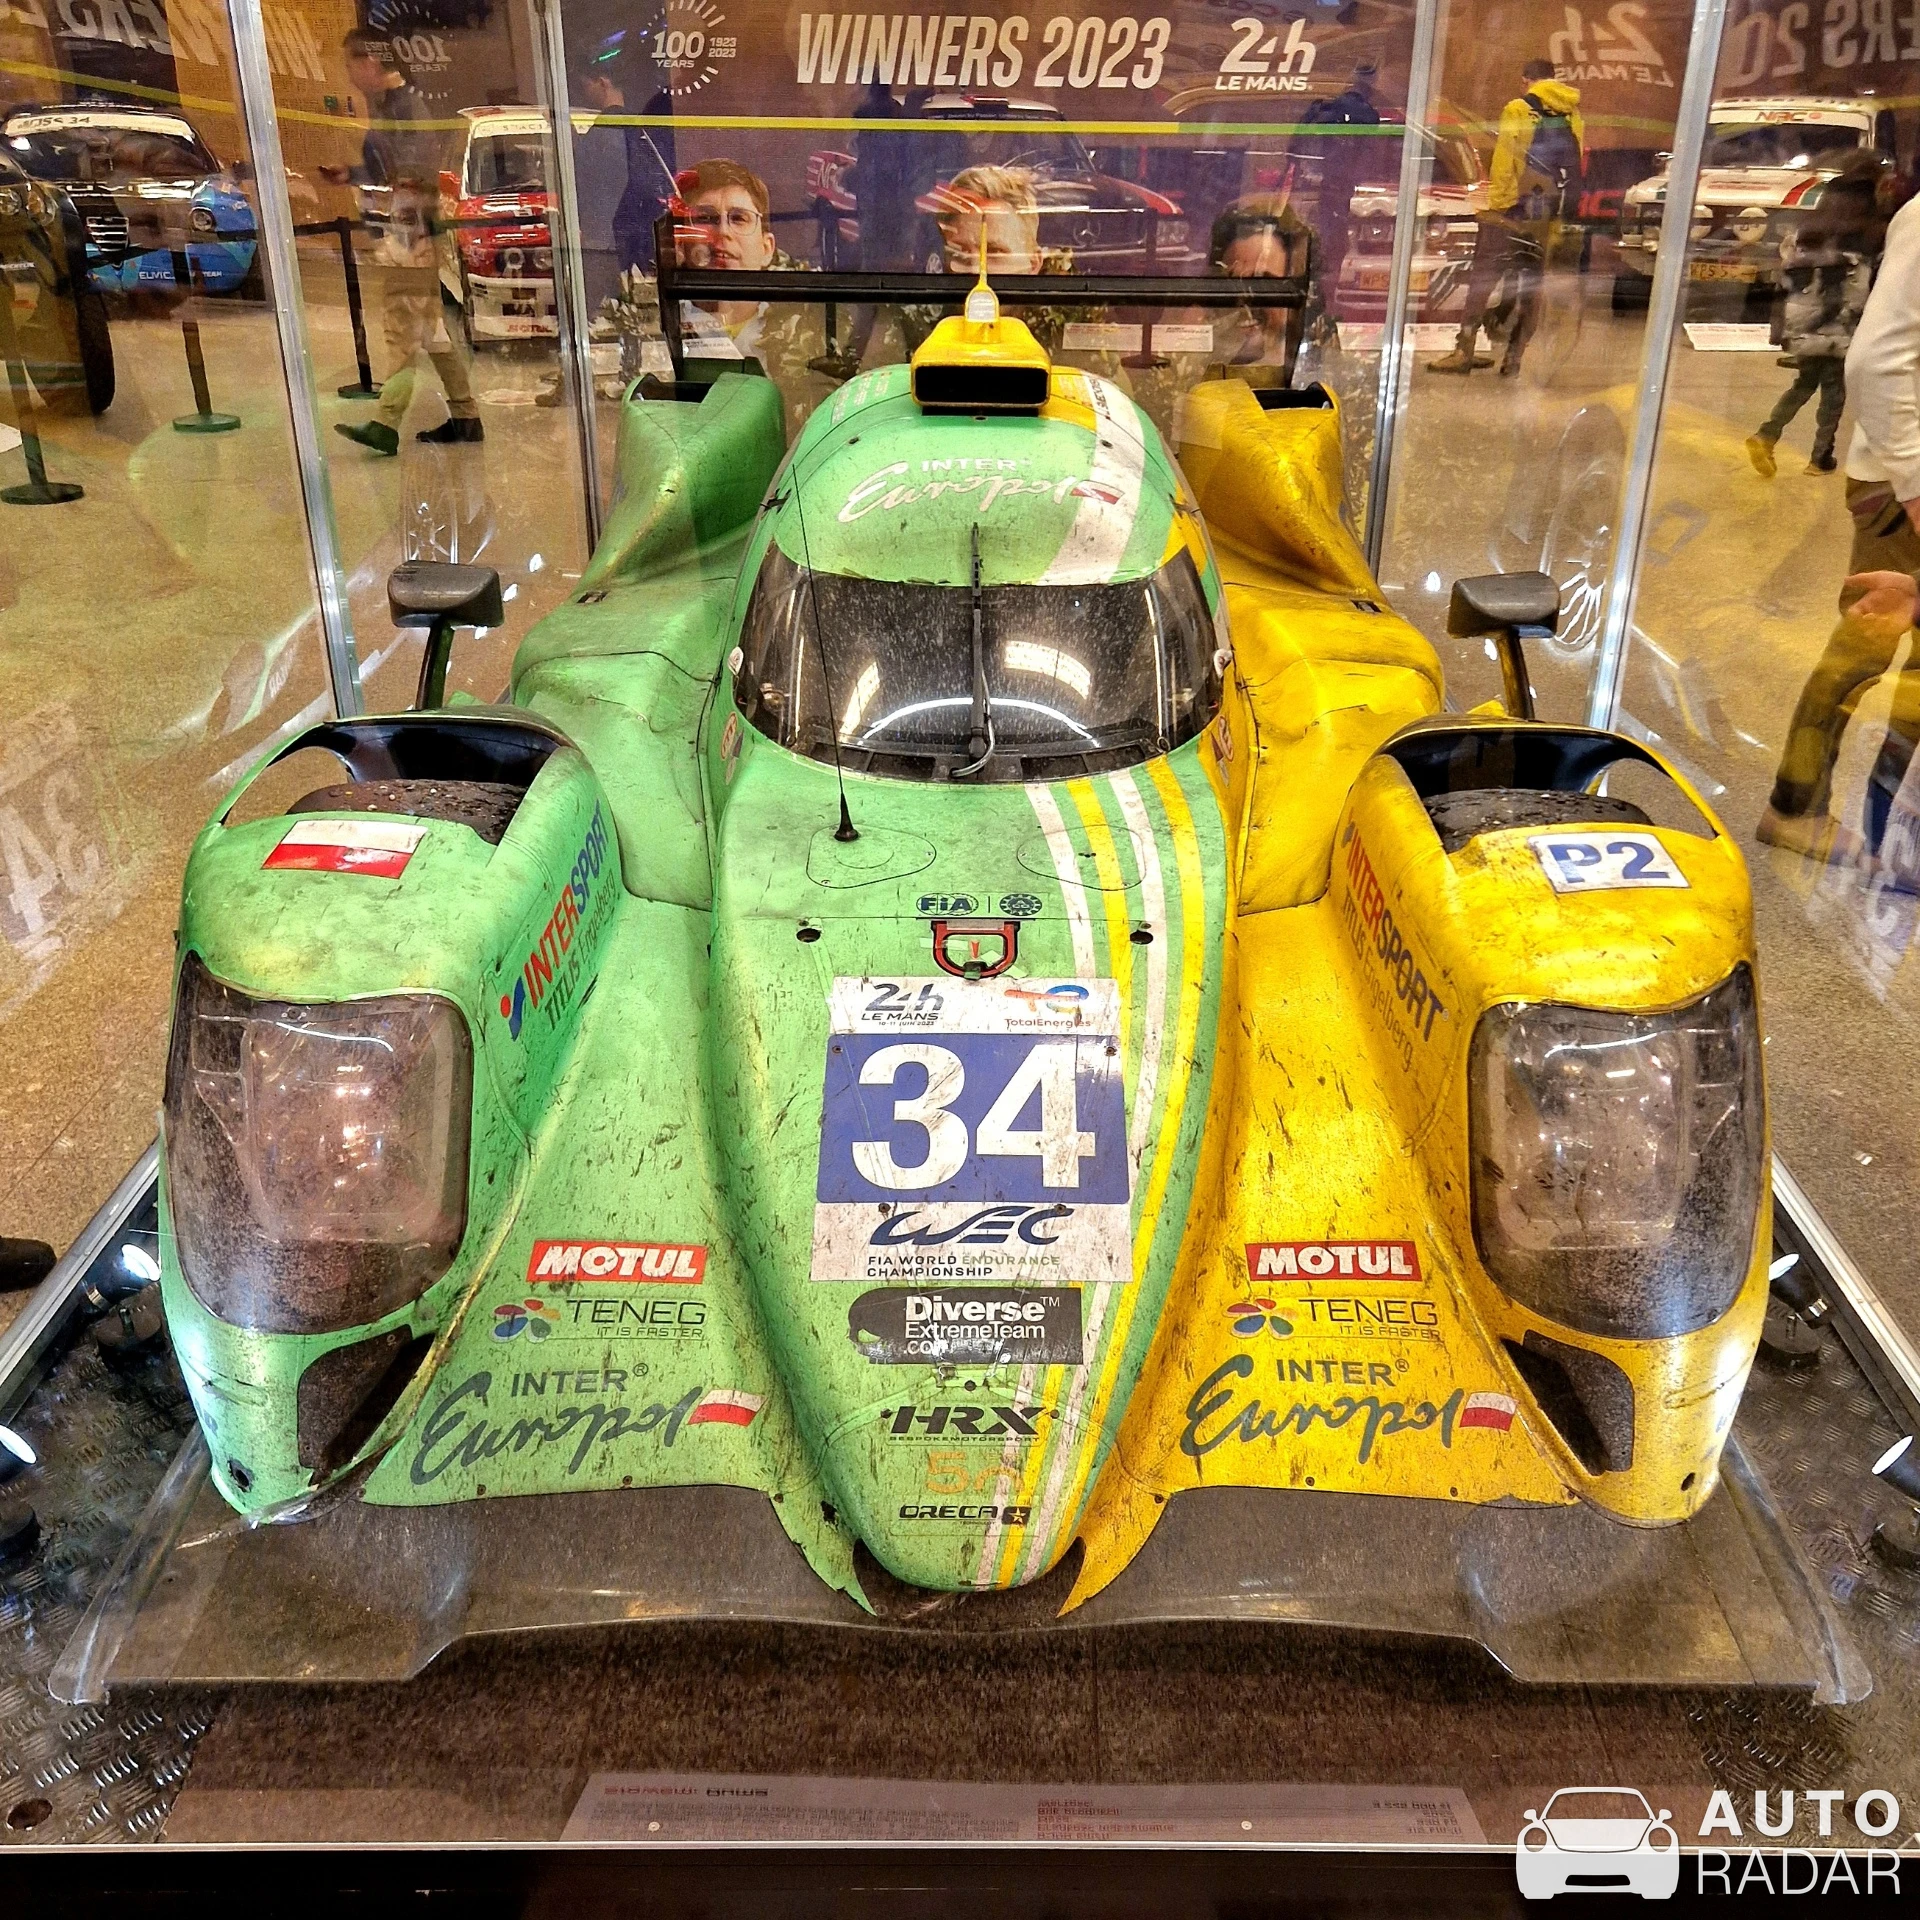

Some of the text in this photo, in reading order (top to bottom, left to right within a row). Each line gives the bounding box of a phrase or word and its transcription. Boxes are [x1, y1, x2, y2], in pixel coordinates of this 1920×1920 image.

[651, 31, 705, 58] 100
[709, 48, 736, 57] 2023
[710, 37, 737, 47] 1923
[797, 14, 1170, 88] WINNERS 2023
[1220, 18, 1316, 73] 24h
[656, 60, 695, 68] YEARS
[1215, 75, 1308, 91] LE MANS
[1547, 841, 1670, 884] P2
[524, 799, 609, 1010] INTERSPORT
[864, 983, 945, 1012] 24h
[861, 1012, 939, 1021] LE MANS
[852, 1043, 1096, 1190] 34
[870, 1206, 1075, 1246] WEC
[536, 1246, 698, 1278] MOTUL
[867, 1267, 993, 1277] CHAMPIONSHIP
[868, 1255, 1060, 1266] FIA WORLD ENDURANCE
[1256, 1246, 1413, 1275] MOTUL
[566, 1300, 706, 1325] TENEG
[1299, 1298, 1438, 1326] TENEG
[636, 1326, 703, 1338] FASTER
[905, 1321, 1046, 1339] ExtremeTeam
[891, 1406, 1046, 1434] HRX
[1180, 1353, 1465, 1465] Europol
[410, 1371, 704, 1485] Europol
[899, 1505, 999, 1518] ORECA
